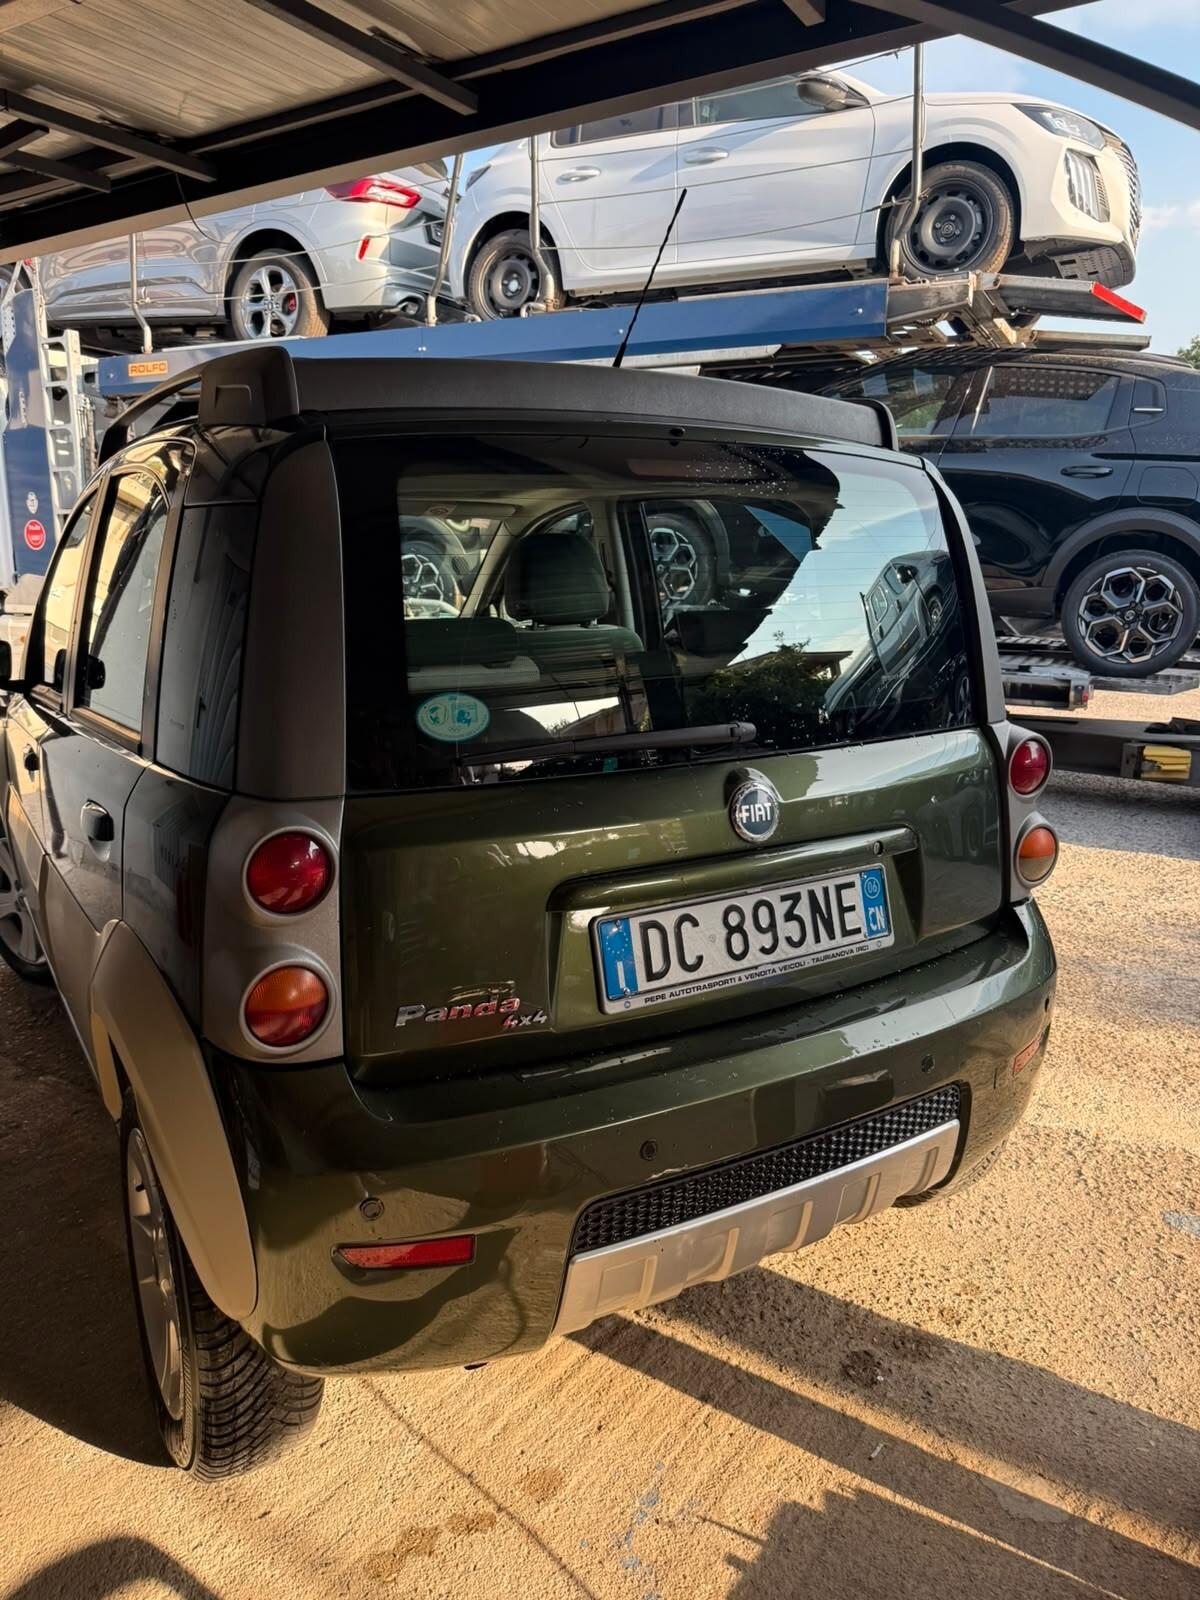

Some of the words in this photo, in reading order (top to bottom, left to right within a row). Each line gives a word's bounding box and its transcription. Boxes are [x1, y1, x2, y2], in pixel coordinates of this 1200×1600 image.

[130, 363, 166, 374] ROLFO
[740, 803, 772, 823] FIAT
[867, 880, 878, 894] 06
[868, 905, 885, 931] CN
[639, 913, 703, 982] DC
[722, 881, 862, 962] 893NE
[644, 993, 666, 1004] PEPE
[669, 978, 736, 998] AUTOTRASPORTI
[744, 968, 777, 980] VENDITA
[778, 961, 806, 973] VEICOLI
[811, 949, 854, 964] TAURIANOVA
[395, 995, 521, 1028] Panda
[503, 1009, 548, 1028] 4x4
